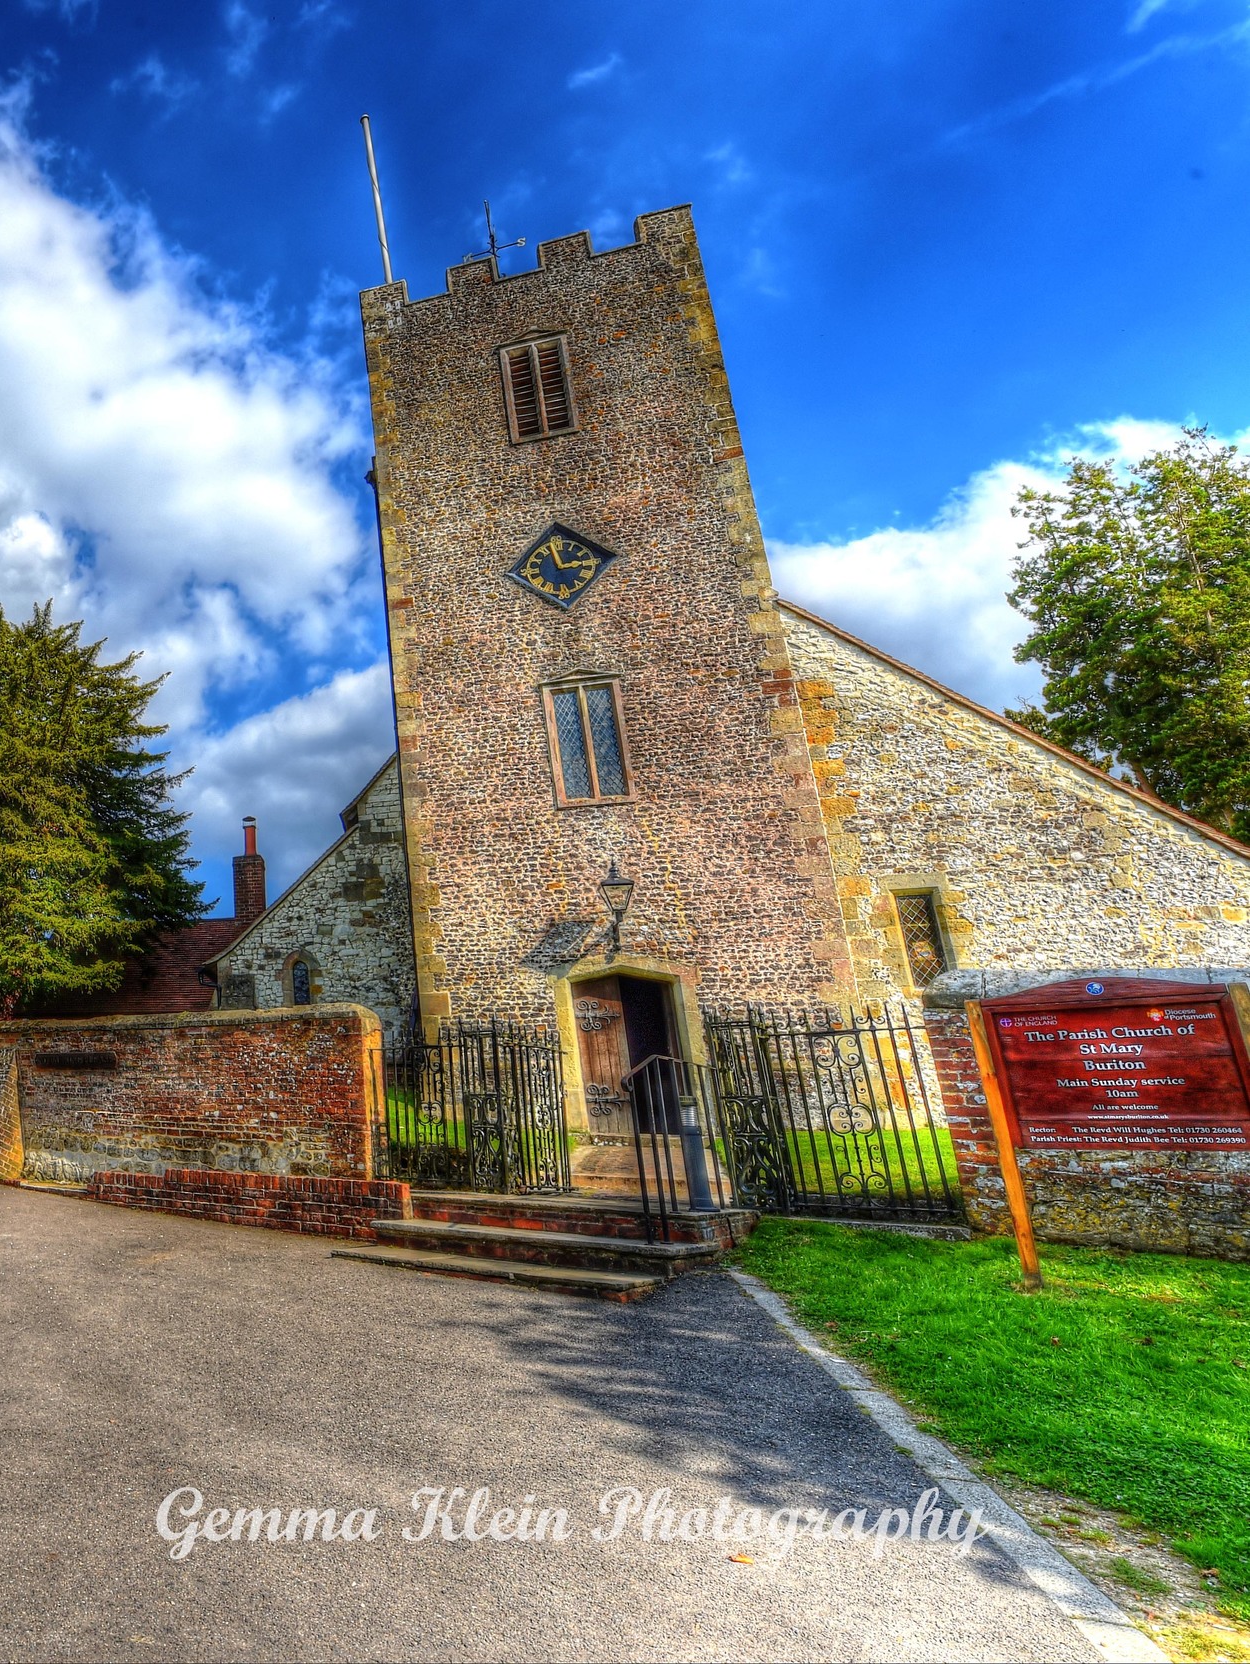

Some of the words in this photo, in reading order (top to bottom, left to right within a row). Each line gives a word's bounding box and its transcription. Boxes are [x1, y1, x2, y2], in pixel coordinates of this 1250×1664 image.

[1170, 1012, 1217, 1021] Portsmouth
[1024, 1031, 1055, 1042] The
[1057, 1028, 1108, 1041] Parish
[1111, 1025, 1174, 1038] Church
[1177, 1024, 1196, 1035] of
[1079, 1043, 1097, 1055] St
[1099, 1043, 1143, 1056] Mary
[1083, 1060, 1146, 1071] Buriton
[1056, 1079, 1089, 1087] Main
[1091, 1078, 1138, 1088] Sunday
[1141, 1076, 1185, 1086] service
[1106, 1090, 1139, 1098] 10am
